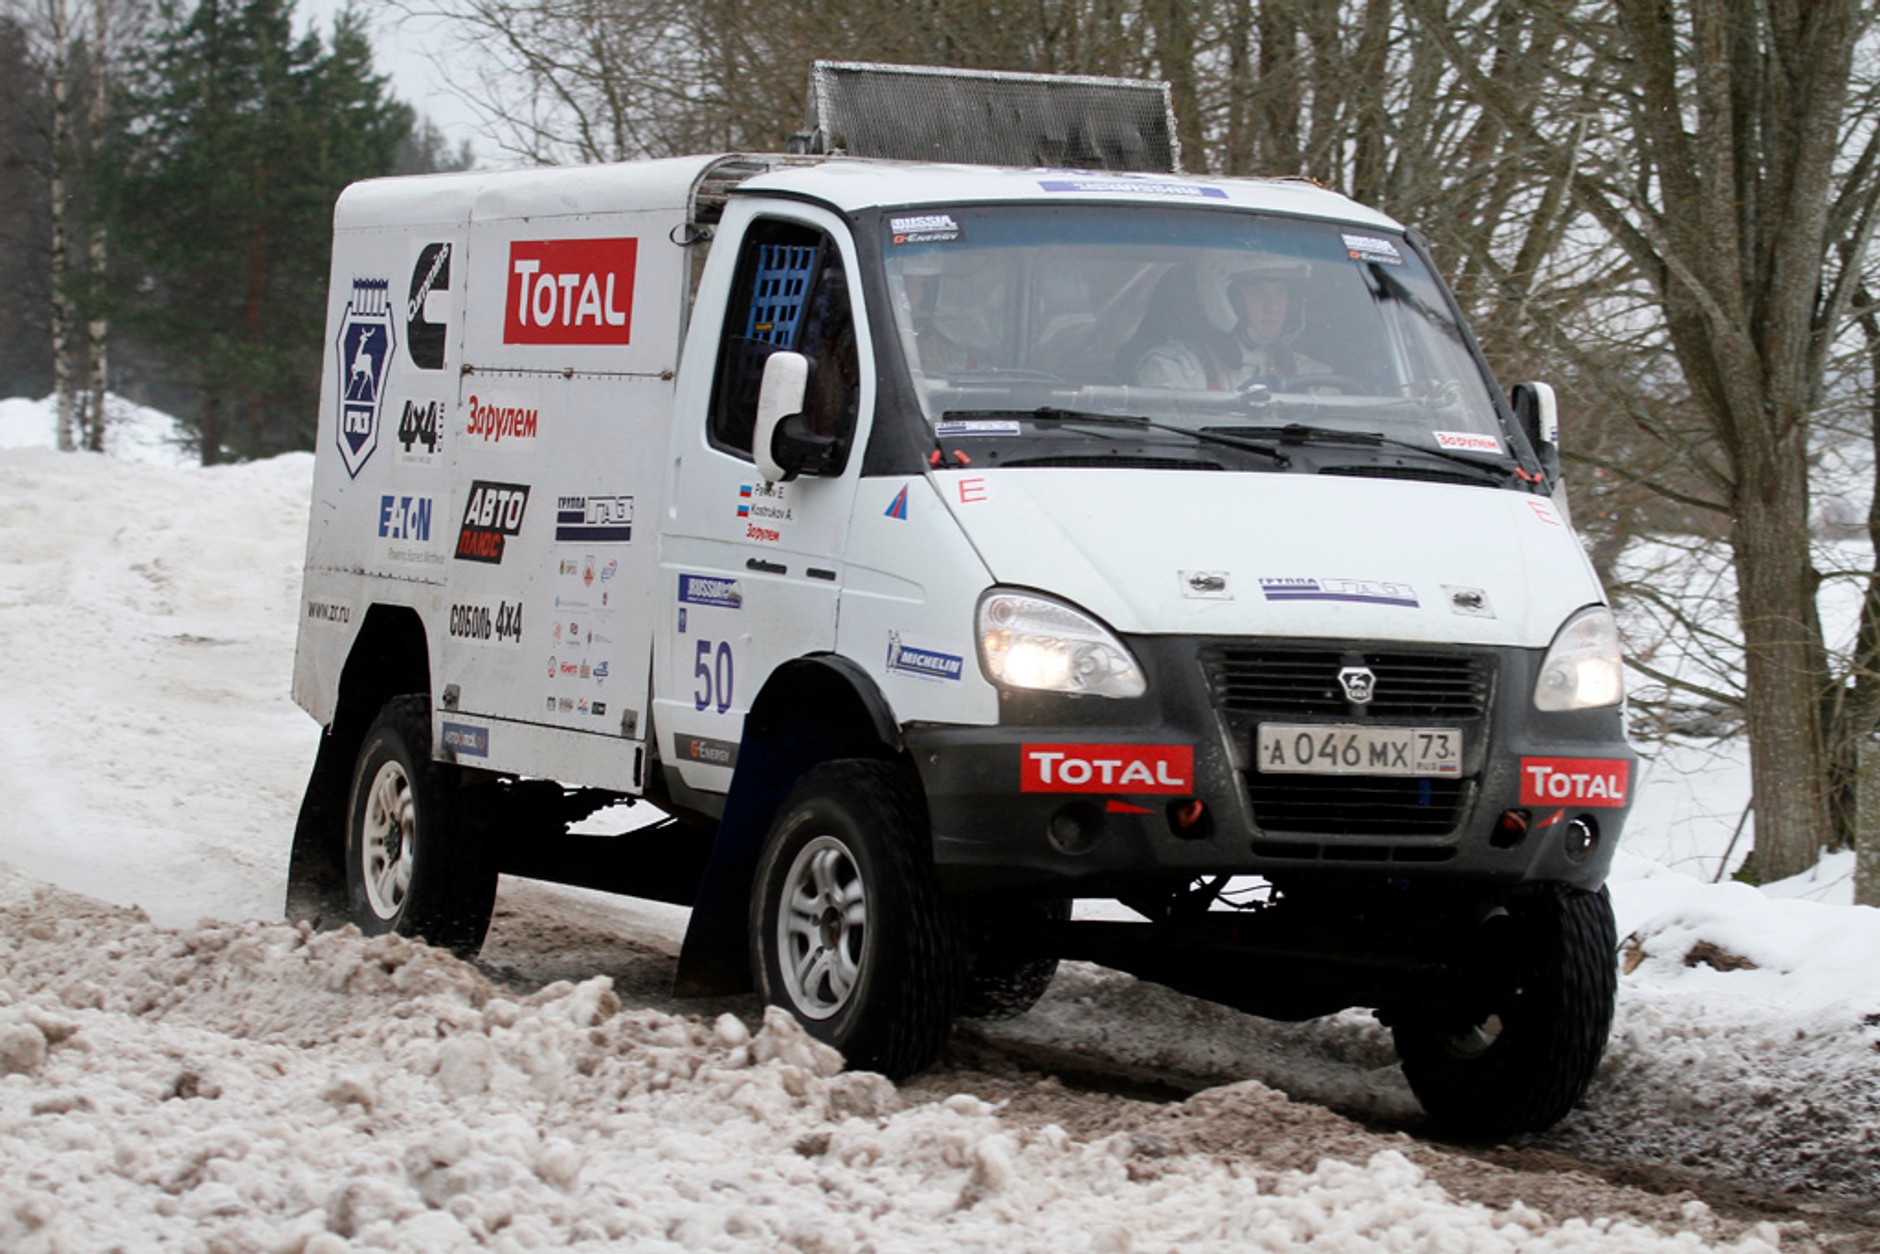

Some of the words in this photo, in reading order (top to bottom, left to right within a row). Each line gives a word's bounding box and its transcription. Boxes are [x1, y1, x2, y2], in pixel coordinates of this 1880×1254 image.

[514, 259, 626, 328] TOTAL
[959, 478, 988, 503] E
[379, 496, 433, 541] EATON
[464, 490, 526, 530] АВТО
[458, 530, 502, 558] ПЛЮС
[694, 639, 734, 714] 50
[902, 651, 960, 673] MICHELIN
[1418, 734, 1449, 759] 73
[1029, 751, 1185, 786] TOTAL
[1527, 766, 1623, 798] TOTAL
